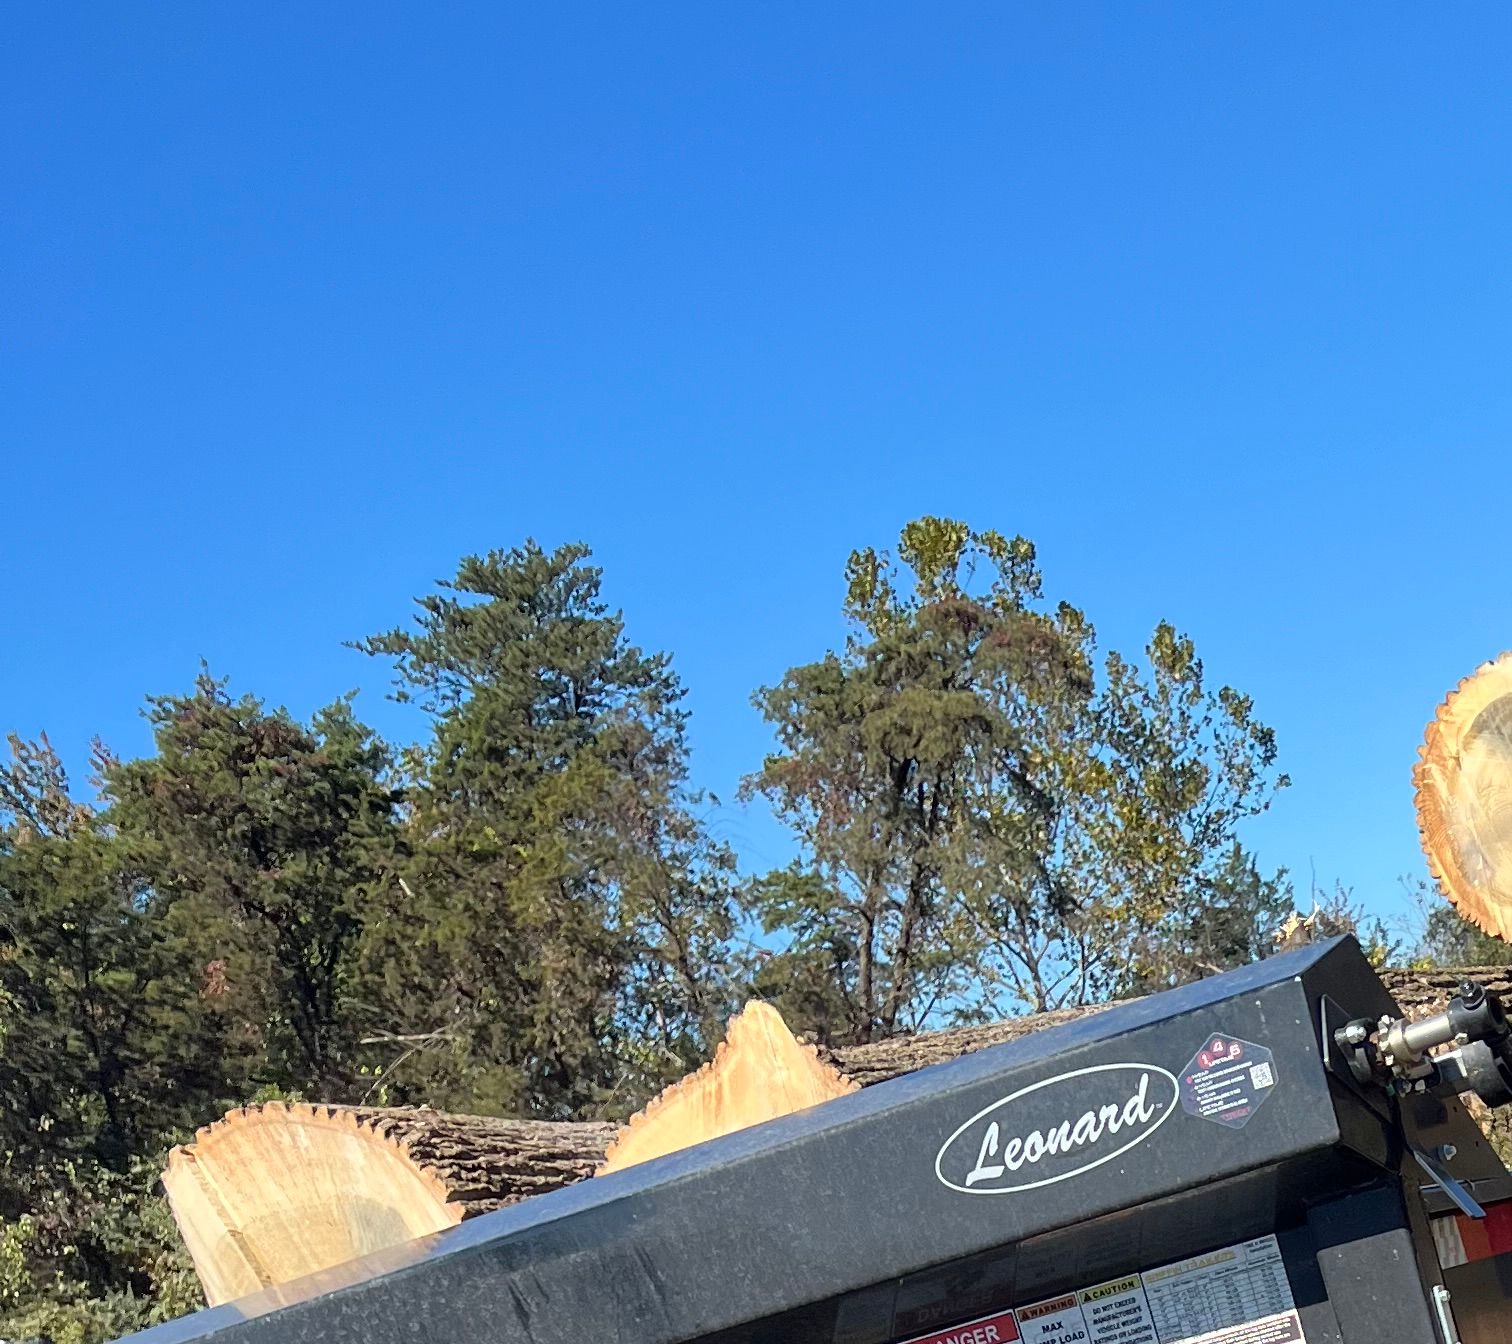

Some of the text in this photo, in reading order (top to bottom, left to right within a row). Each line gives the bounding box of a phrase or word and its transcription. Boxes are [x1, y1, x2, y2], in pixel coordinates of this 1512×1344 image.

[965, 1072, 1156, 1187] Leonard
[1092, 1281, 1135, 1299] CAUTION
[1030, 1299, 1075, 1317] WARNING
[1041, 1320, 1065, 1334] MAX
[1060, 1330, 1085, 1344] LOAD
